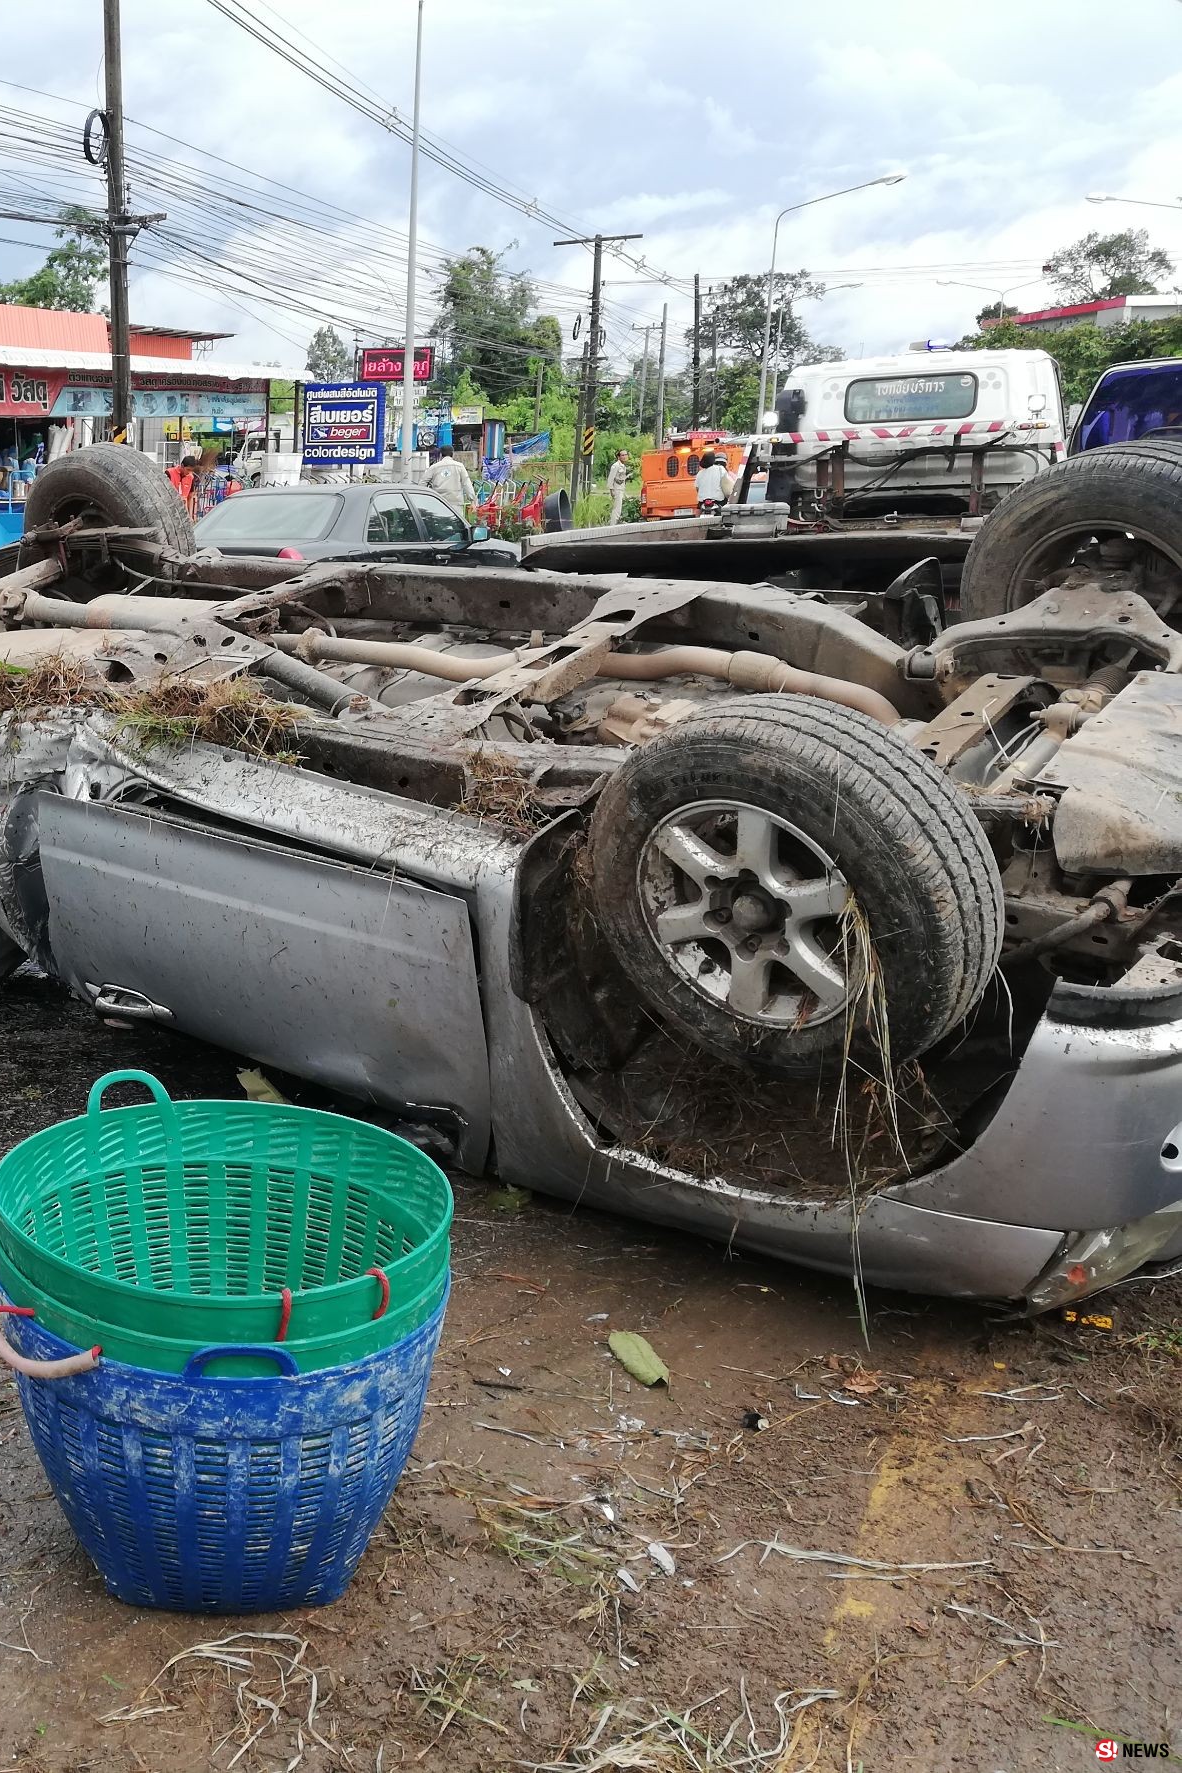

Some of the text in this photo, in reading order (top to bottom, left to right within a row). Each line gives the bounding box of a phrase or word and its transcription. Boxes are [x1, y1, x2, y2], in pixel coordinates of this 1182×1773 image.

[365, 358, 402, 372] ยล้าง
[10, 372, 49, 411] วัสดุ
[306, 387, 377, 401] ศูนย์ผสมสีอัตโนมัติ
[309, 404, 374, 423] สีเบเยอร์
[330, 427, 367, 439] beger
[304, 446, 376, 460] colordesign
